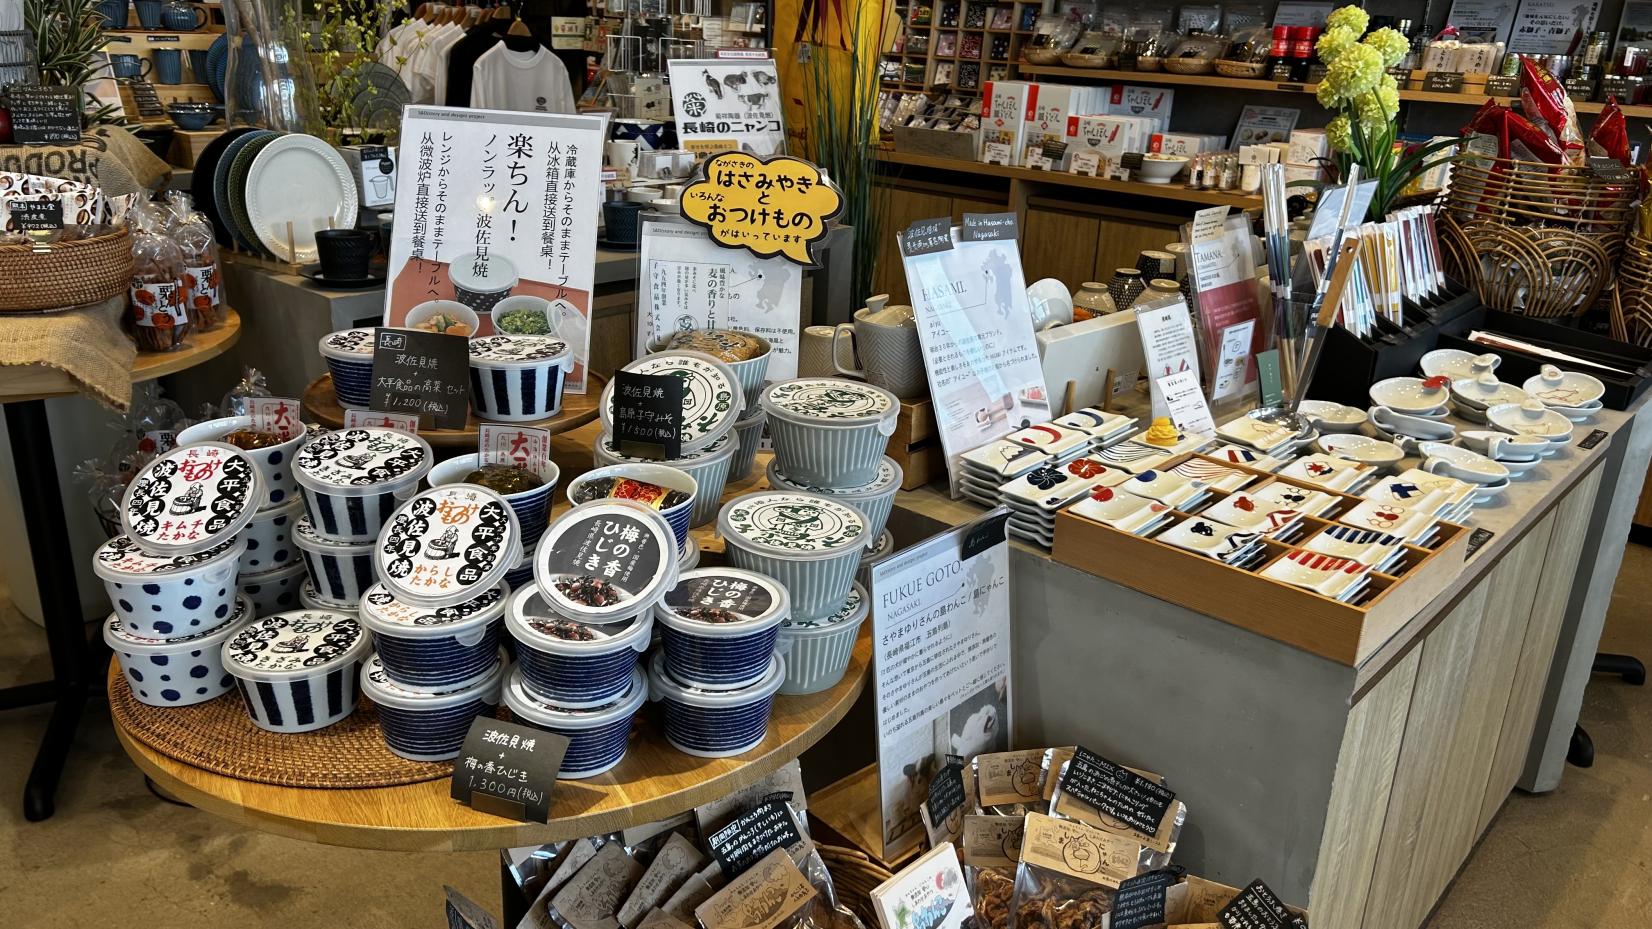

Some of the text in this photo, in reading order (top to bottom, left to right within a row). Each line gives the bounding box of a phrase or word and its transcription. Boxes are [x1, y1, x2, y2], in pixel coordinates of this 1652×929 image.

[682, 120, 781, 135] 長崎のニャンコ
[715, 159, 754, 169] ながさきの
[502, 132, 534, 243] 楽ちん！
[717, 171, 812, 194] はさみやき
[690, 191, 725, 203] いろんな
[757, 191, 771, 205] と
[427, 131, 453, 305] レンジからそのままテーブルへ。
[707, 204, 813, 230] おつけもの
[555, 144, 578, 317] 冷蔵庫からそのままテーブルへ。
[720, 229, 802, 244] がはいっています
[395, 353, 439, 370] 波佐見焼
[377, 376, 465, 395] 大平食品の高菜 セット
[622, 383, 665, 399] 波佐見焼
[423, 400, 449, 415] (税込)
[187, 449, 219, 458] 長崎
[177, 459, 222, 482] おつけもの
[134, 461, 177, 536] 波佐見焼
[207, 458, 246, 532] 大平食品
[436, 499, 479, 524] おつけもの
[157, 529, 200, 541] たかな
[161, 519, 204, 531] キムチ
[388, 500, 435, 577] 波佐見焼
[458, 503, 501, 582] 大平食品
[585, 521, 620, 571] ひじき
[602, 524, 640, 578] 梅の香
[415, 563, 453, 577] からし
[410, 575, 451, 589] たかな
[700, 579, 728, 605] ひじき
[883, 577, 923, 609] FUKUE
[718, 581, 748, 609] 梅の香
[887, 600, 921, 622] NAGASAKI
[304, 620, 358, 666] 大平食品
[482, 729, 536, 752] 波佐見焼
[464, 755, 528, 783] 梅の香ひじき
